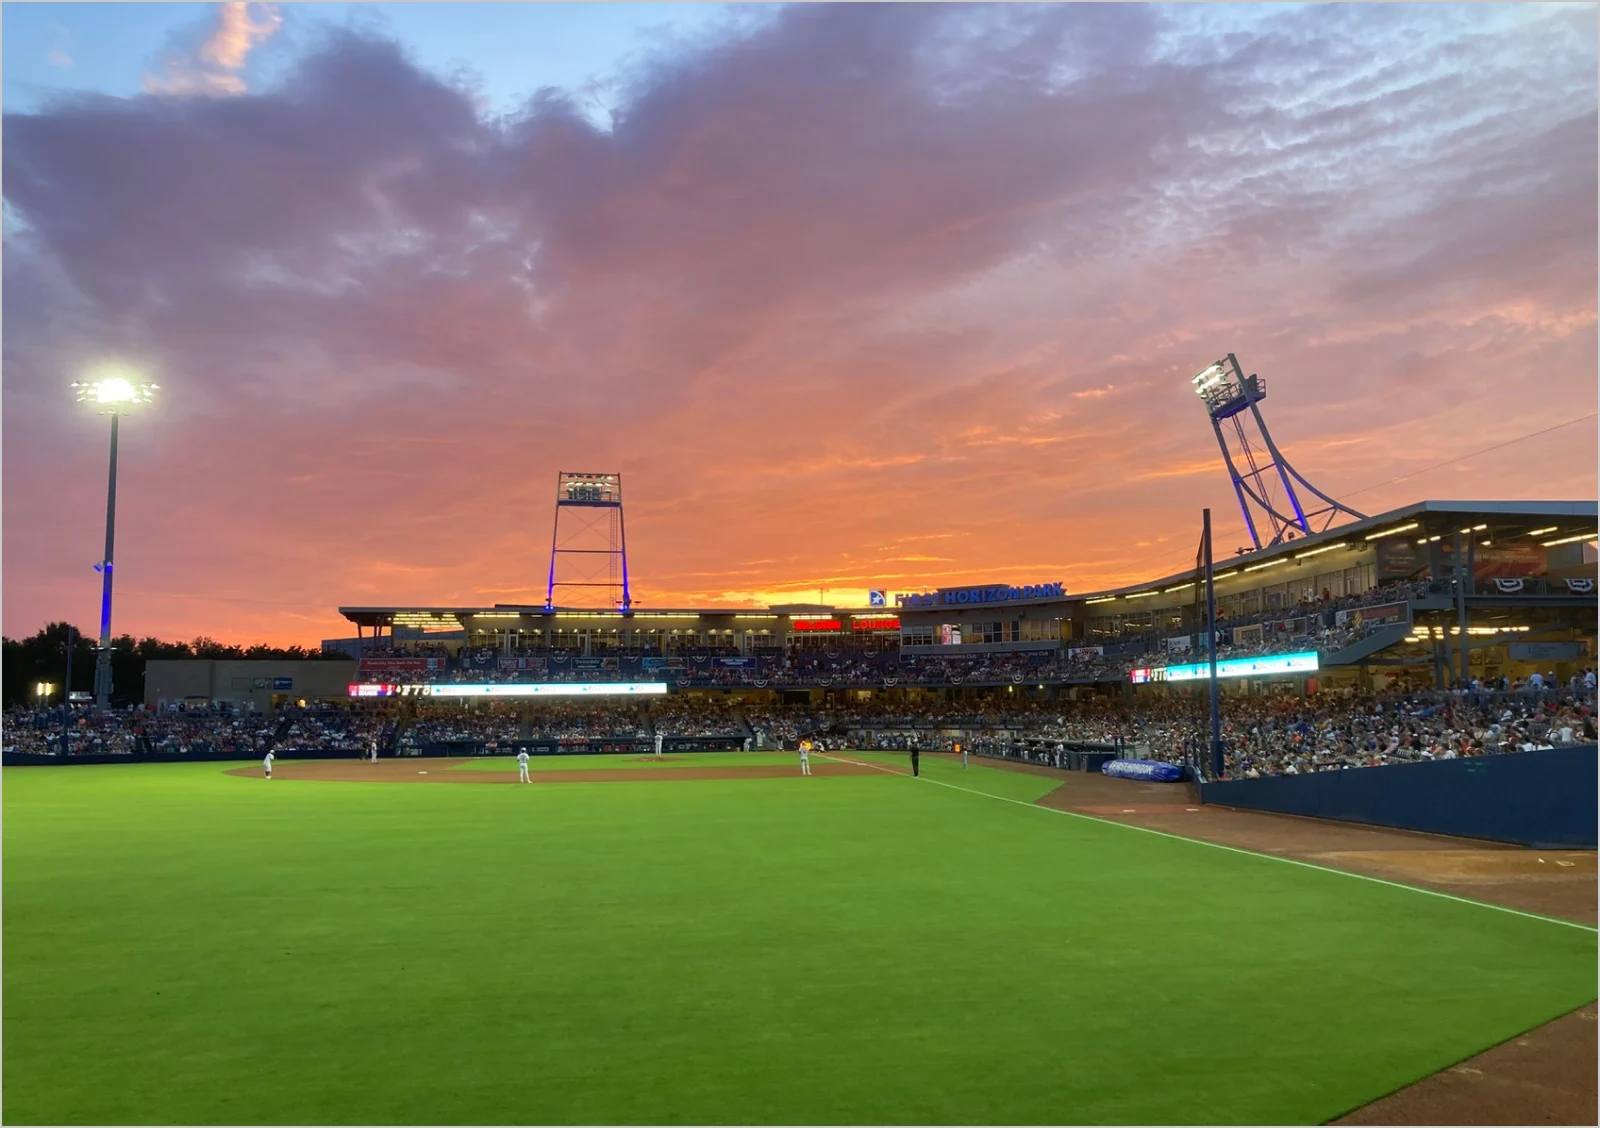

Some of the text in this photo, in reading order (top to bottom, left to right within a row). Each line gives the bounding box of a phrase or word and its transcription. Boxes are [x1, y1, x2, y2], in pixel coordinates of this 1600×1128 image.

[944, 587, 1021, 604] HORIZON
[1023, 582, 1064, 599] PARK
[852, 618, 902, 630] LOUNGE
